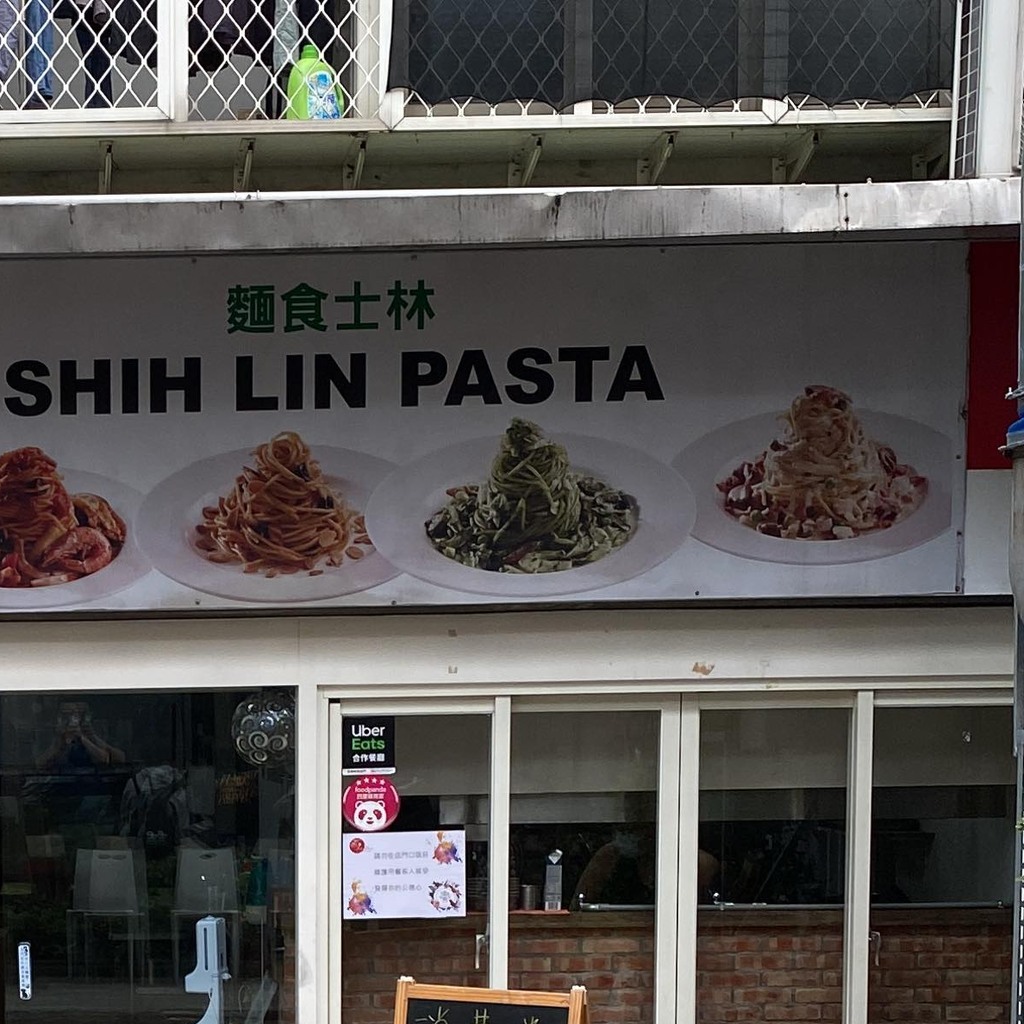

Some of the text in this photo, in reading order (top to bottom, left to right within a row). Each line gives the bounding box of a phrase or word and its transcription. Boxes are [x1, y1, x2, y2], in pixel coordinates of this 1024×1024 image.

[226, 281, 435, 335] 麵食士林
[4, 345, 665, 417] SHIH LIN PASTA
[351, 725, 385, 737] Uber
[351, 738, 385, 750] Eats
